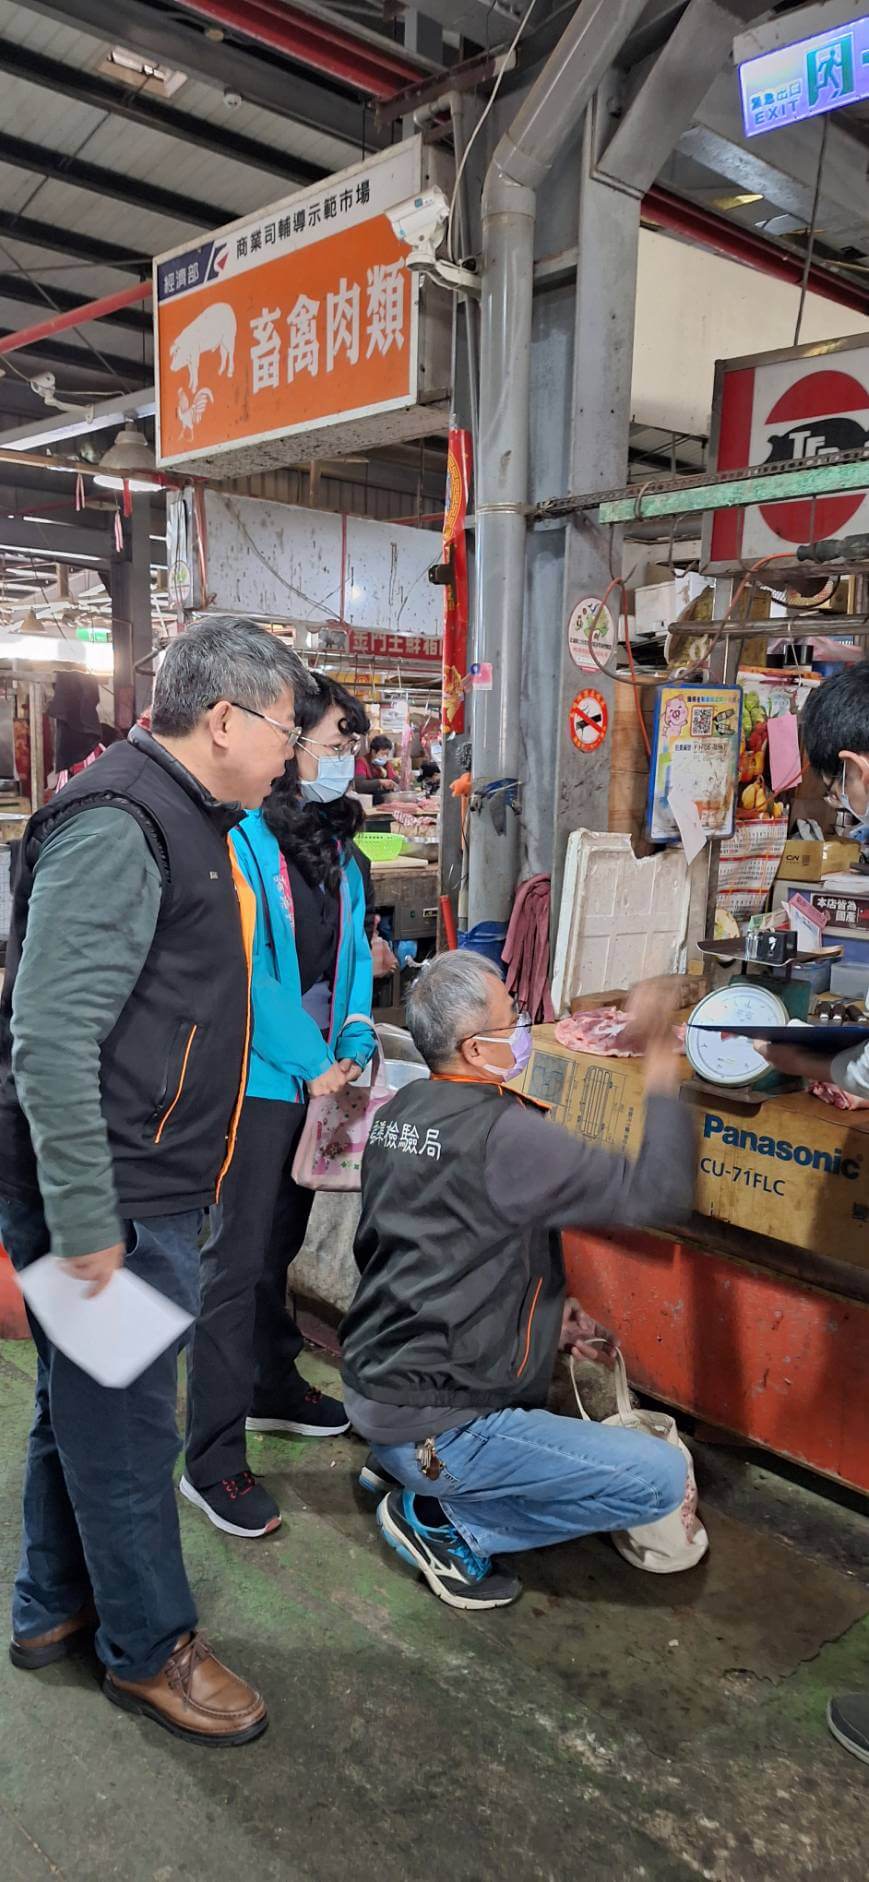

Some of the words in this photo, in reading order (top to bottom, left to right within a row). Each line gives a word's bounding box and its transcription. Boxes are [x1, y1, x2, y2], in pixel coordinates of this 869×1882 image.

[755, 99, 798, 124] EXIT
[236, 179, 370, 260] 商業司輔導示範市場
[163, 261, 199, 294] 經濟部
[249, 258, 405, 395] 畜禽肉類
[703, 1113, 861, 1181] Panasonic
[700, 1157, 786, 1197] CU-71FLC
